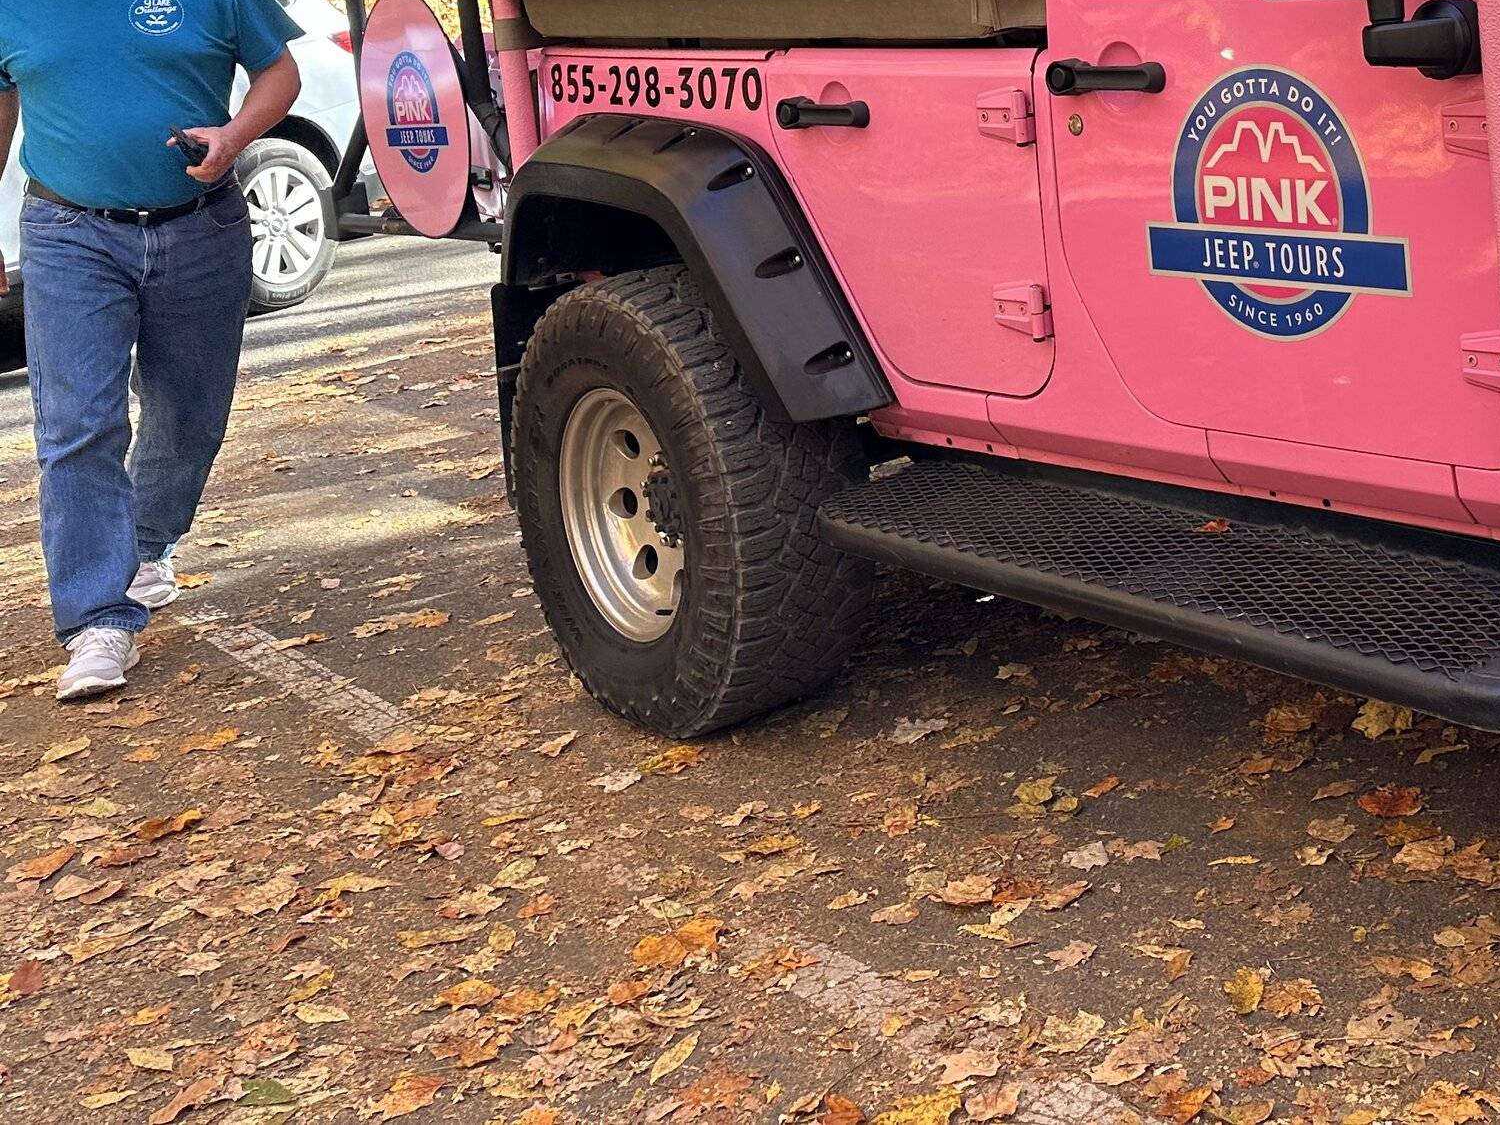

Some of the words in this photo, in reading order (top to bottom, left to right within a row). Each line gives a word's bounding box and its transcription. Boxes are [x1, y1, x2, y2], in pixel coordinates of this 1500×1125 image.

[134, 6, 177, 15] Challenge
[550, 63, 763, 112] 855-298-3070
[395, 100, 431, 122] PINK
[1187, 101, 1216, 143] YOU
[1220, 78, 1280, 104] GOTTA
[1287, 86, 1314, 114] DO
[1317, 113, 1343, 146] IT!
[400, 131, 415, 144] JEEP
[416, 130, 436, 144] TOURS
[1202, 174, 1332, 226] PINK
[1265, 242, 1345, 278] TOURS
[1228, 294, 1278, 327] SINCE
[1285, 302, 1324, 327] 1960
